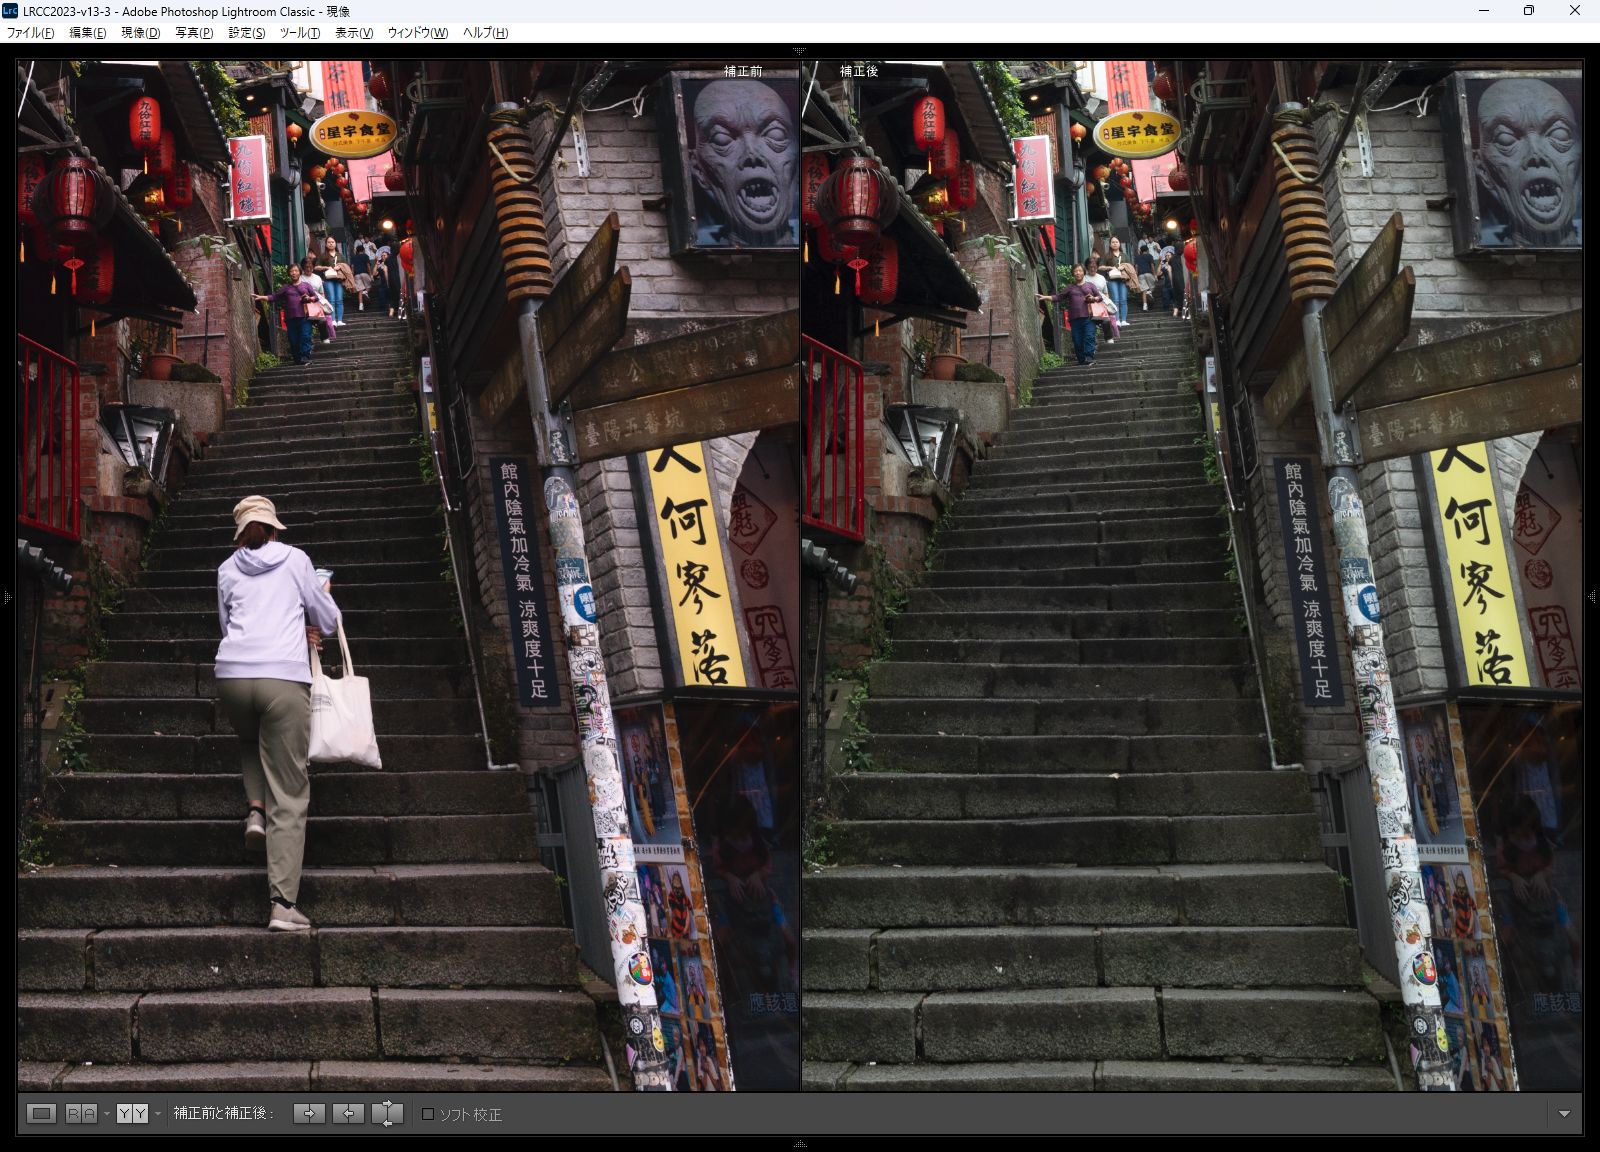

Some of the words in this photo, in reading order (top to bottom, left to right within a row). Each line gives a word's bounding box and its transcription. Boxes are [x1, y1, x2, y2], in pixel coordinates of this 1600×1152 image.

[3, 6, 18, 15] Lrc
[23, 6, 111, 17] LRCC2023-v13-3
[121, 6, 158, 17] Adobe
[160, 6, 219, 20] Photoshop
[222, 6, 277, 20] Lightroom
[279, 6, 316, 17] Classic
[326, 5, 351, 18] 現像
[7, 26, 55, 40] ファイル(F)
[69, 26, 107, 40] 編集(E)
[121, 26, 161, 40] 現像(D)
[175, 26, 214, 40] 写真(P)
[228, 26, 266, 40] 設定(S)
[280, 26, 321, 40] ツール(T)
[335, 26, 374, 40] 表示(V)
[388, 26, 449, 40] ウィンドウ(W)
[463, 26, 509, 40] ヘルプ(H)
[327, 122, 391, 139] 星宇食堂
[1111, 122, 1175, 139] 星宇食堂
[234, 144, 256, 215] 九份紅樓
[518, 600, 549, 699] 涼爽度十足
[1302, 600, 1333, 699] 涼爽度十足
[440, 1107, 503, 1122] ソフト校正
